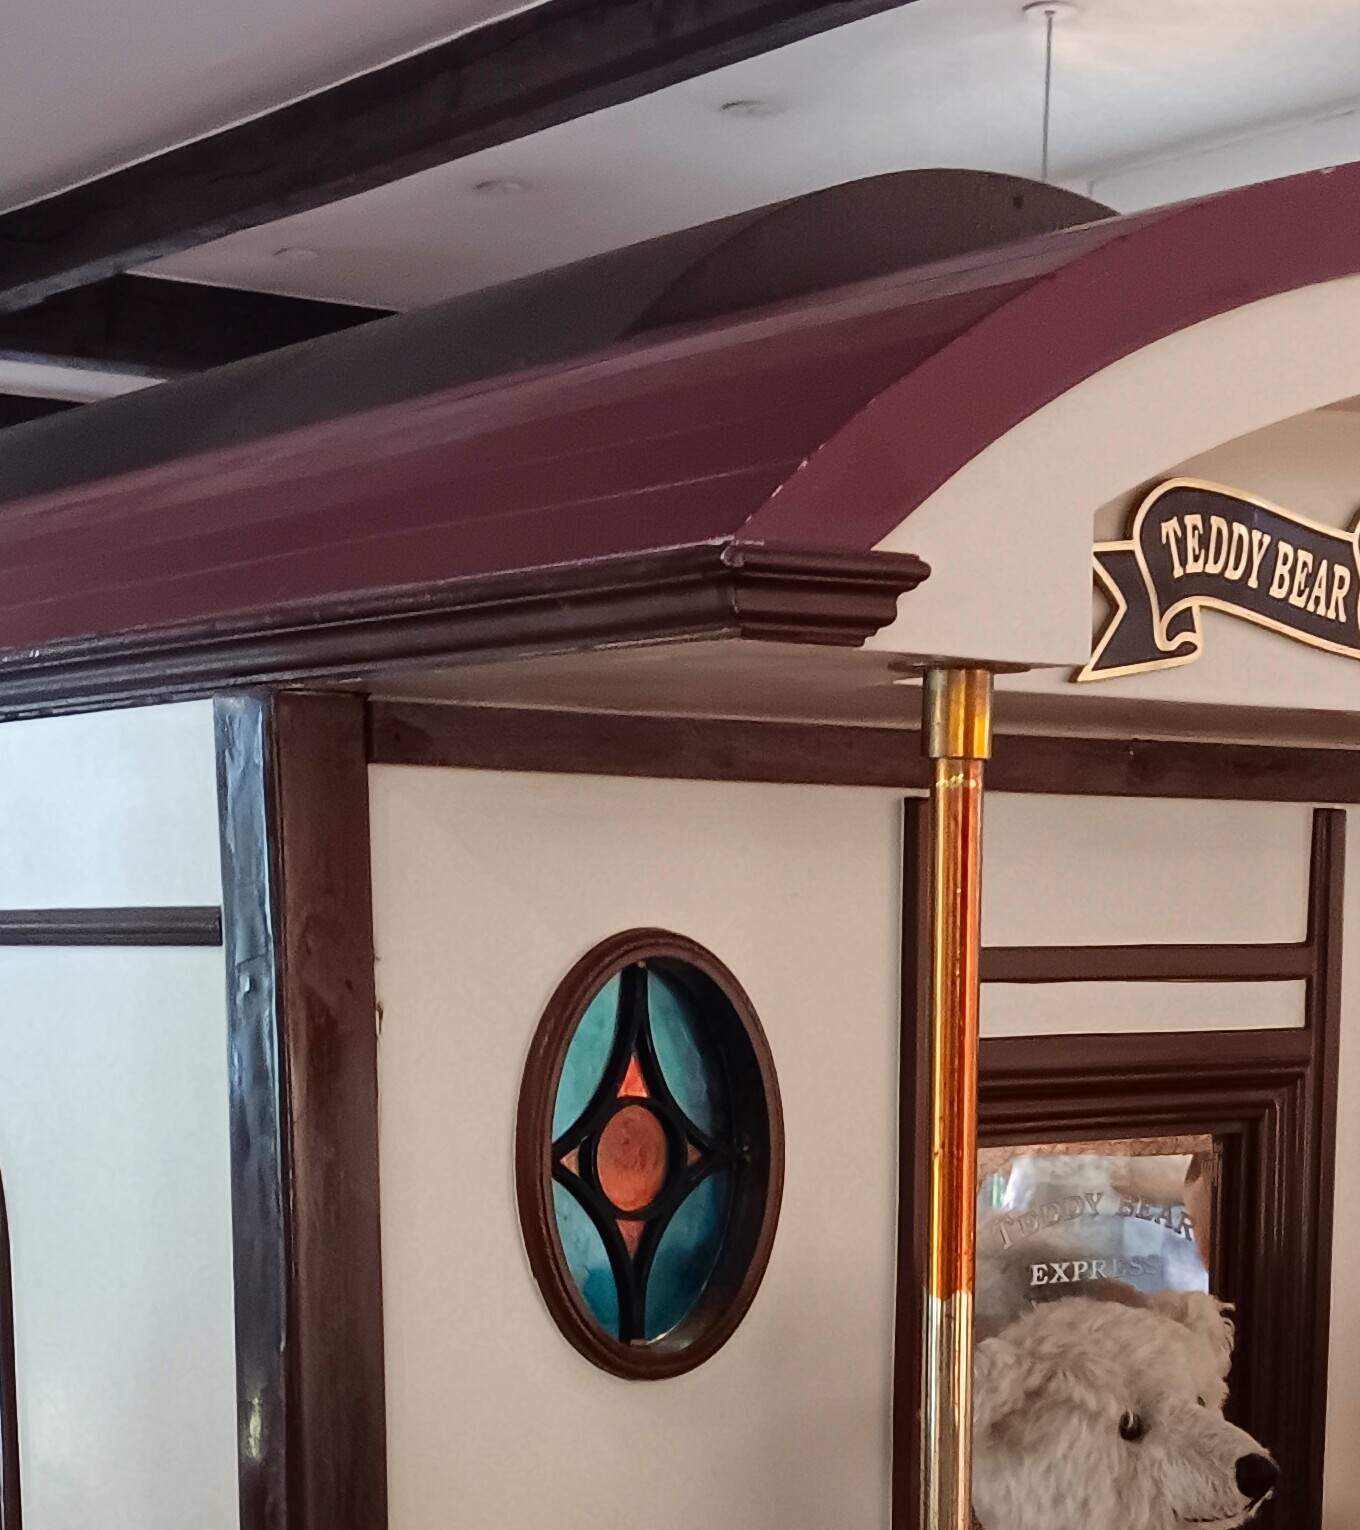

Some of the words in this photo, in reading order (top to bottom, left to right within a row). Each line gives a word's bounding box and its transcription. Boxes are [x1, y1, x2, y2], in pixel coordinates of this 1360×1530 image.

[1161, 514, 1270, 589] TEDDY
[1269, 541, 1352, 623] BEAR
[993, 1192, 1104, 1250] TEDDY
[1115, 1197, 1195, 1242] BEAR
[1030, 1254, 1160, 1287] EXPRESS
